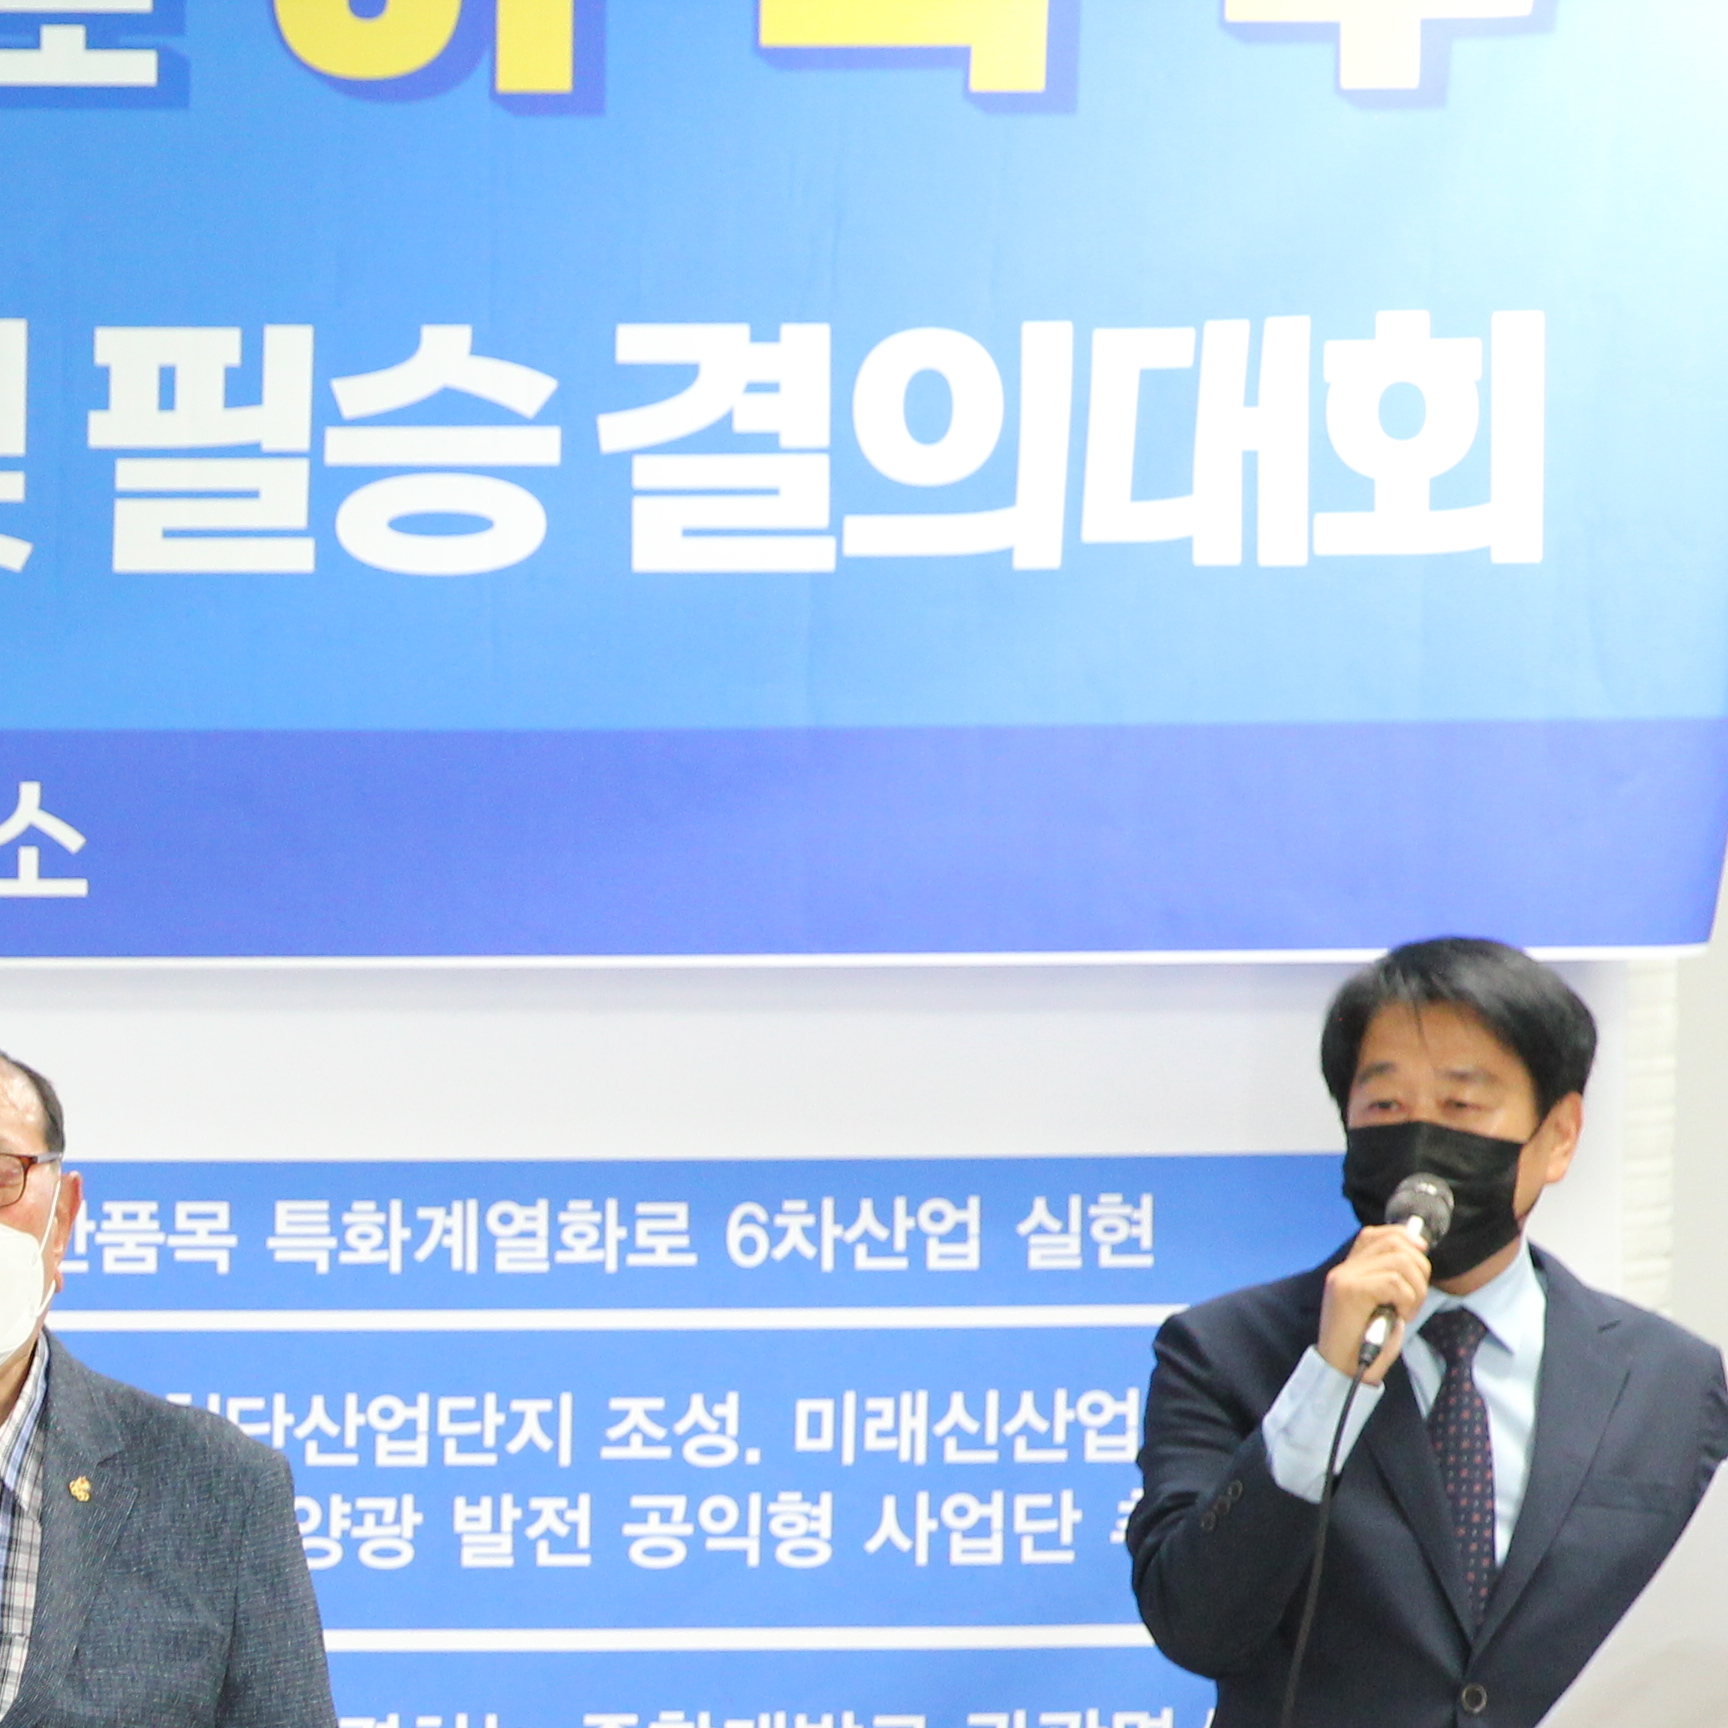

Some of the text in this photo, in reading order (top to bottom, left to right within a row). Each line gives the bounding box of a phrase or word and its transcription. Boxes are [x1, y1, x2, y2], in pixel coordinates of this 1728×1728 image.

[88, 322, 562, 575] 필승
[597, 309, 1547, 574] 결의대회
[264, 1198, 699, 1276] 특화계열화로
[726, 1195, 981, 1273] 6차산업
[1016, 1193, 1155, 1270] 실현
[599, 1391, 762, 1468] 조성.
[793, 1387, 1141, 1466] 미래신산업
[453, 1492, 592, 1568] 발전
[621, 1491, 834, 1570] 공익형
[863, 1488, 1084, 1567] 사업단
